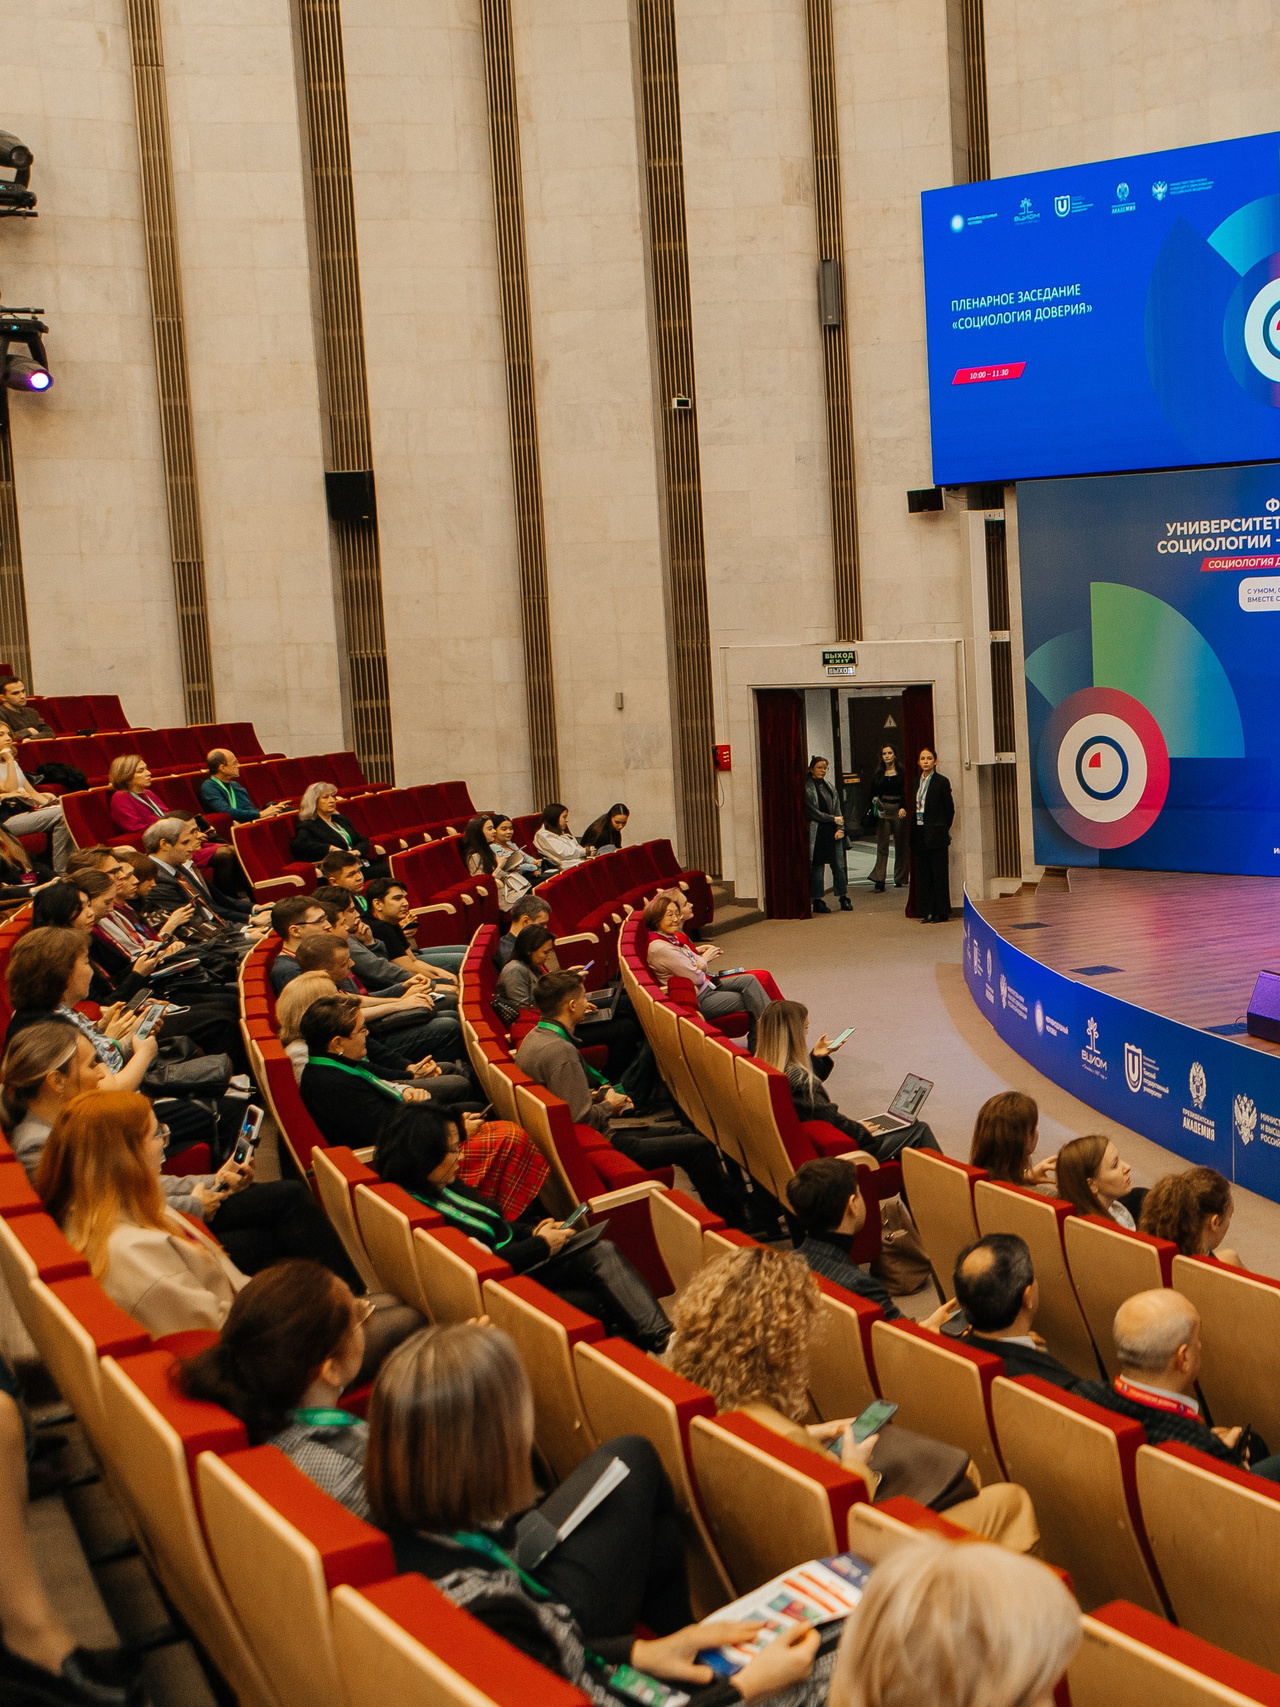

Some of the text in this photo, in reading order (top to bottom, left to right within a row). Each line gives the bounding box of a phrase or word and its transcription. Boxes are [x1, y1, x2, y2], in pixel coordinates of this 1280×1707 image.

[951, 283, 1081, 312] ПЛЕНАРНОЕ ЗАСЕДАНИЕ
[952, 302, 1092, 330] «СОЦИОЛОГИЯ ДОВЕРИЯ»
[970, 371, 986, 380] 10:00
[992, 368, 1009, 378] 11:30
[1157, 534, 1271, 554] СОЦИОЛОГИИ
[1208, 556, 1274, 570] СОЦИОЛОГИЯ
[1183, 1116, 1215, 1141] АКАДЕМИЯ
